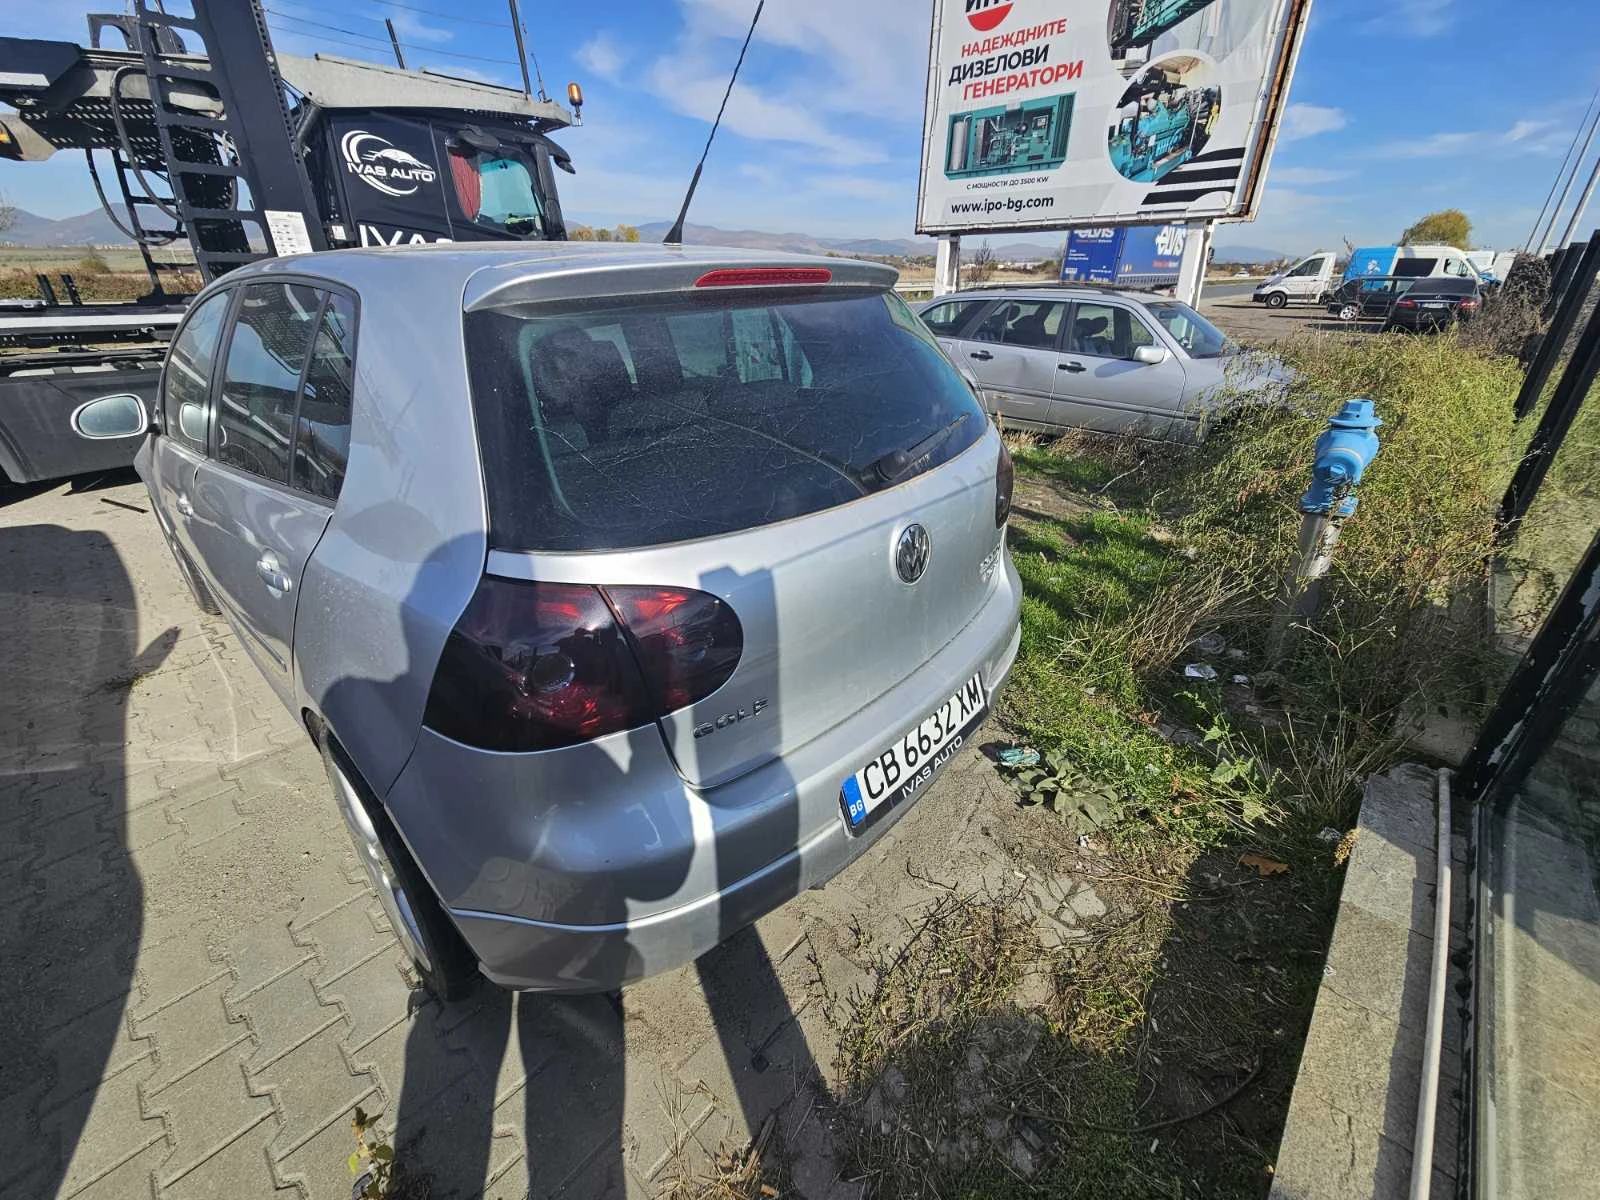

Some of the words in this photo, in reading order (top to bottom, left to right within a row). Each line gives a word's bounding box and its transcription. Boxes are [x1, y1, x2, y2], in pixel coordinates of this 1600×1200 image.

[961, 18, 1067, 58] НАДЕЖДНИТЕ
[948, 43, 1050, 86] ДИЗЕЛОВИ
[963, 60, 1084, 100] ГЕНЕРАТОРИ
[391, 167, 434, 182] AUTO
[951, 196, 1054, 214] www.ipo-bg.com
[693, 699, 768, 739] GOLF
[863, 748, 901, 800] CB
[903, 700, 956, 768] 6632
[955, 671, 981, 722] XM
[902, 769, 932, 798] IVAS
[933, 735, 963, 769] AUTO
[849, 799, 863, 817] BG
